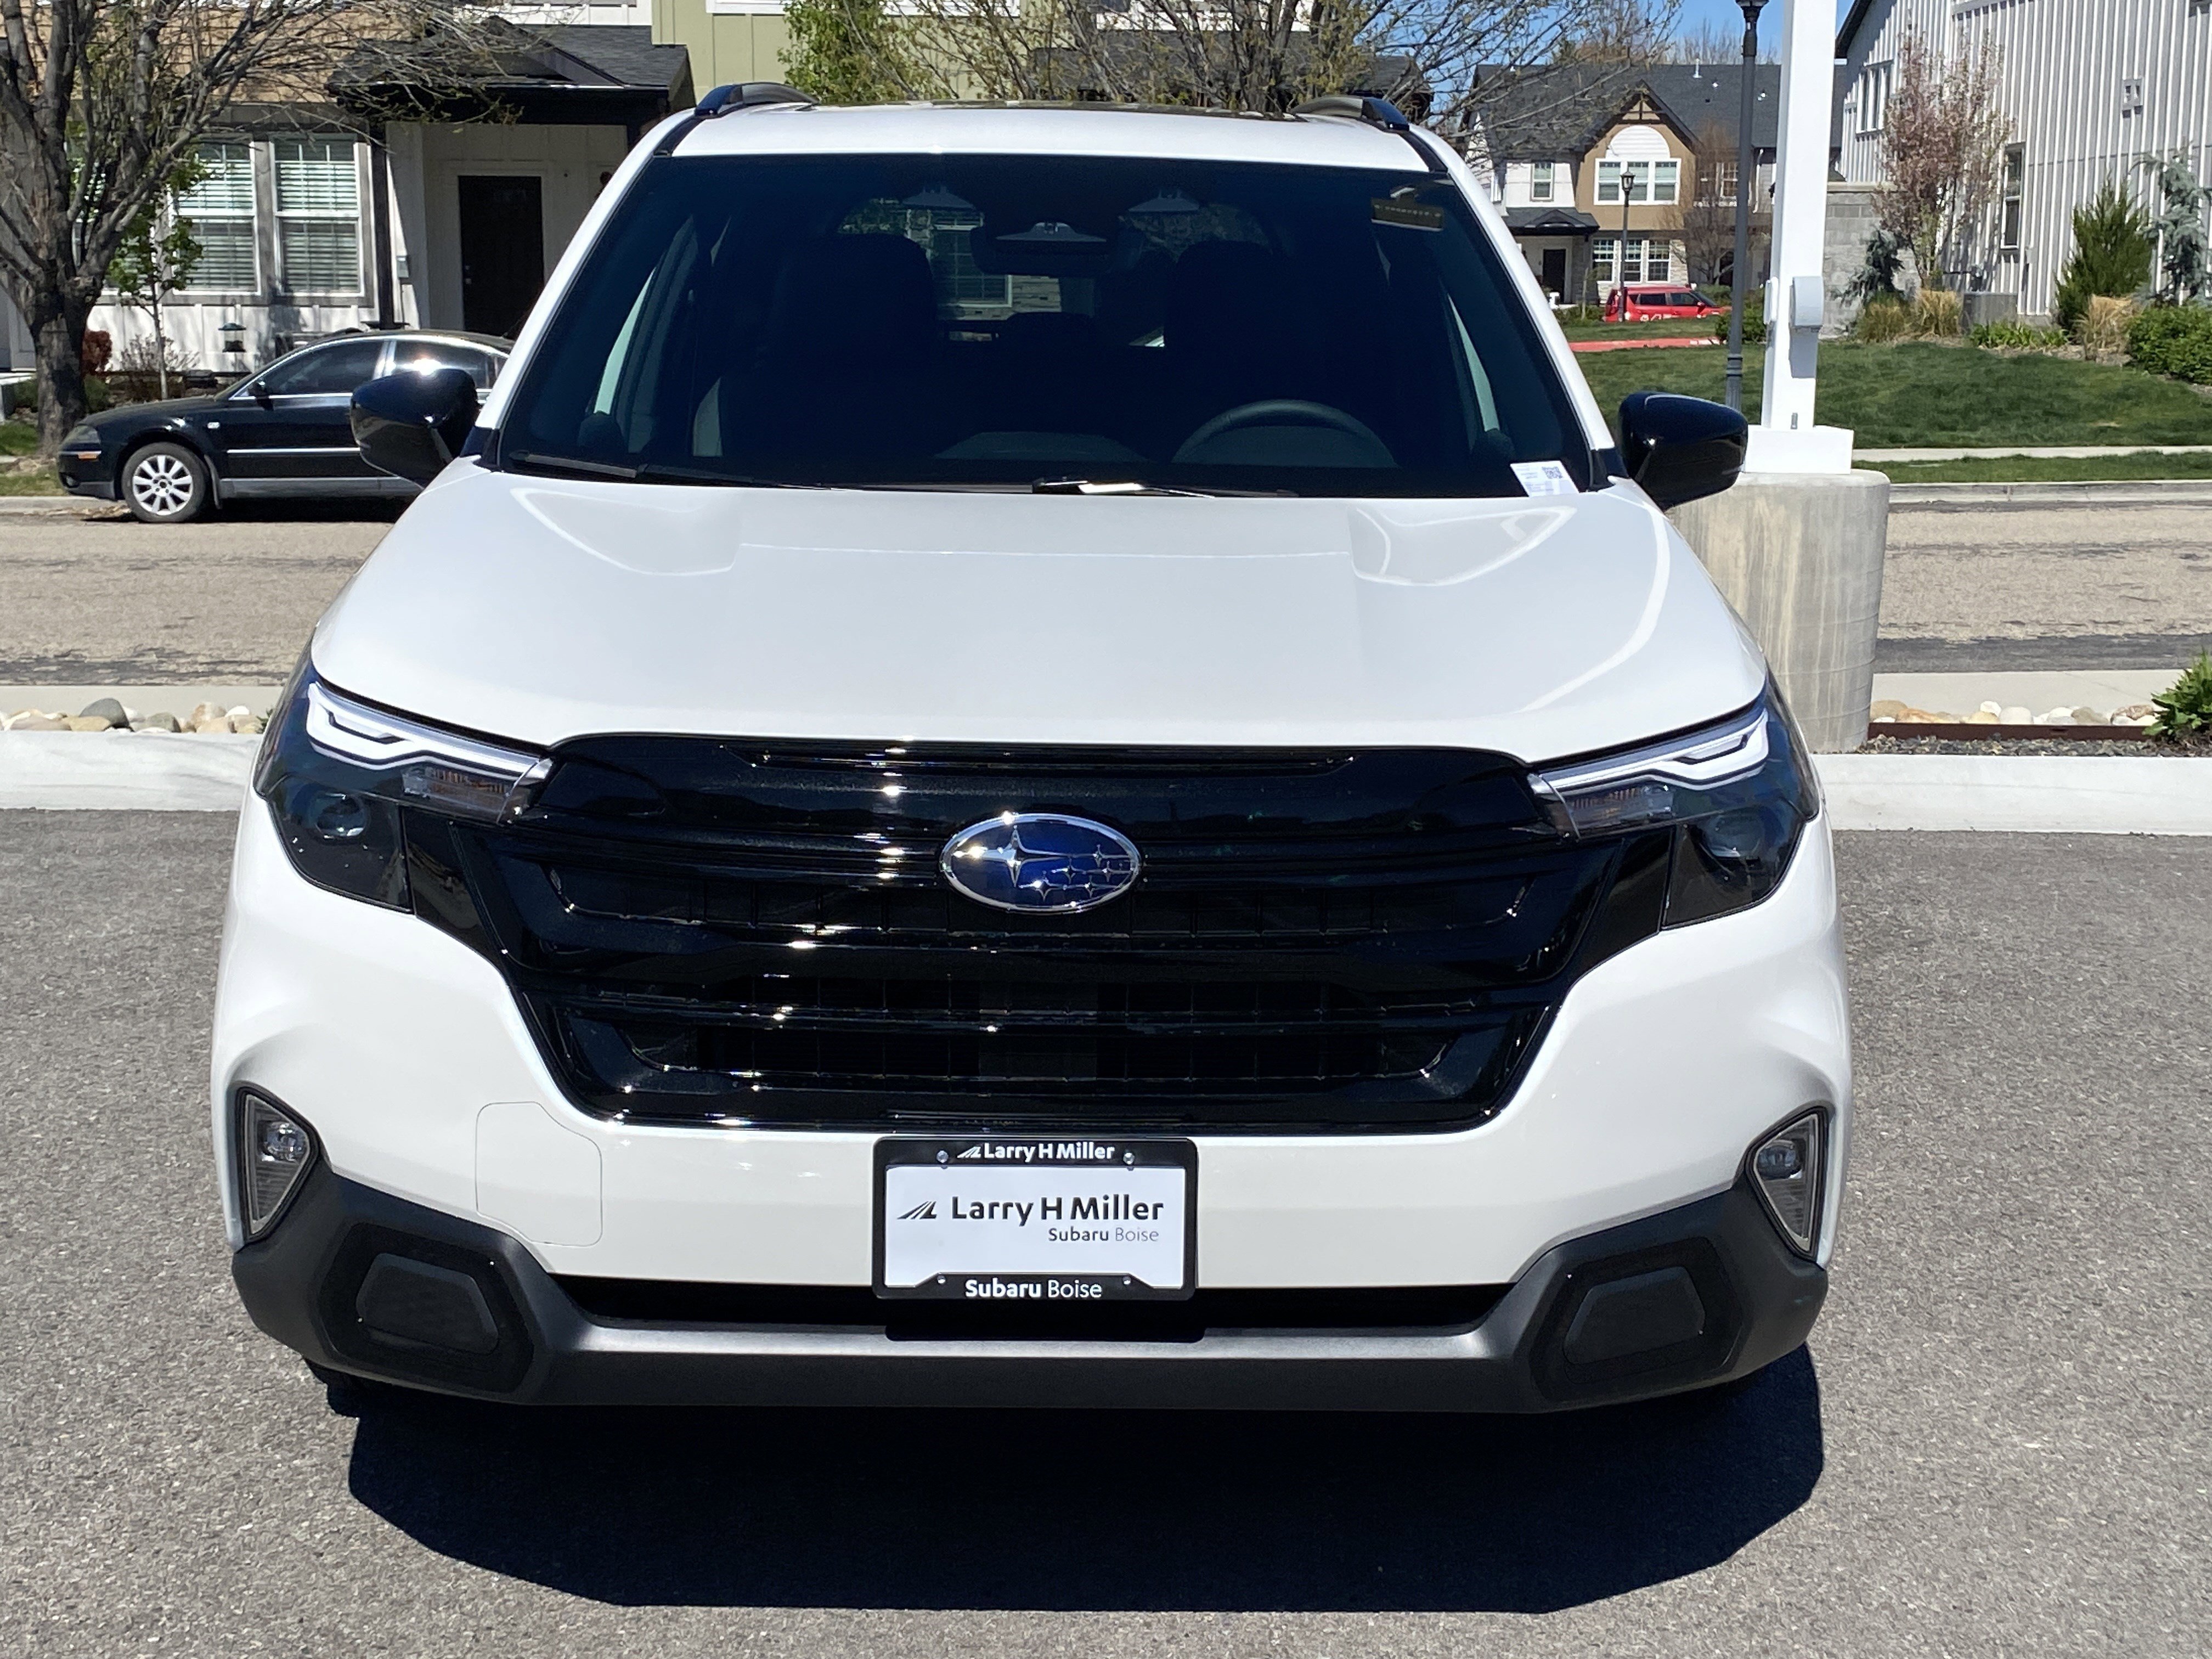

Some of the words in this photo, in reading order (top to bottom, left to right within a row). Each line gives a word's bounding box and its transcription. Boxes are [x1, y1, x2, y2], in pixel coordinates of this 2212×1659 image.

[984, 1142, 1036, 1163] Larry
[1039, 1143, 1053, 1159] H
[1056, 1141, 1115, 1159] Miller
[951, 1196, 1034, 1227] Larry
[1040, 1197, 1063, 1220] H
[1070, 1193, 1164, 1220] Miller
[1048, 1226, 1109, 1242] Subaru
[1115, 1226, 1159, 1242] Boise
[965, 1277, 1042, 1297] Subaru
[1047, 1279, 1102, 1298] Boise
